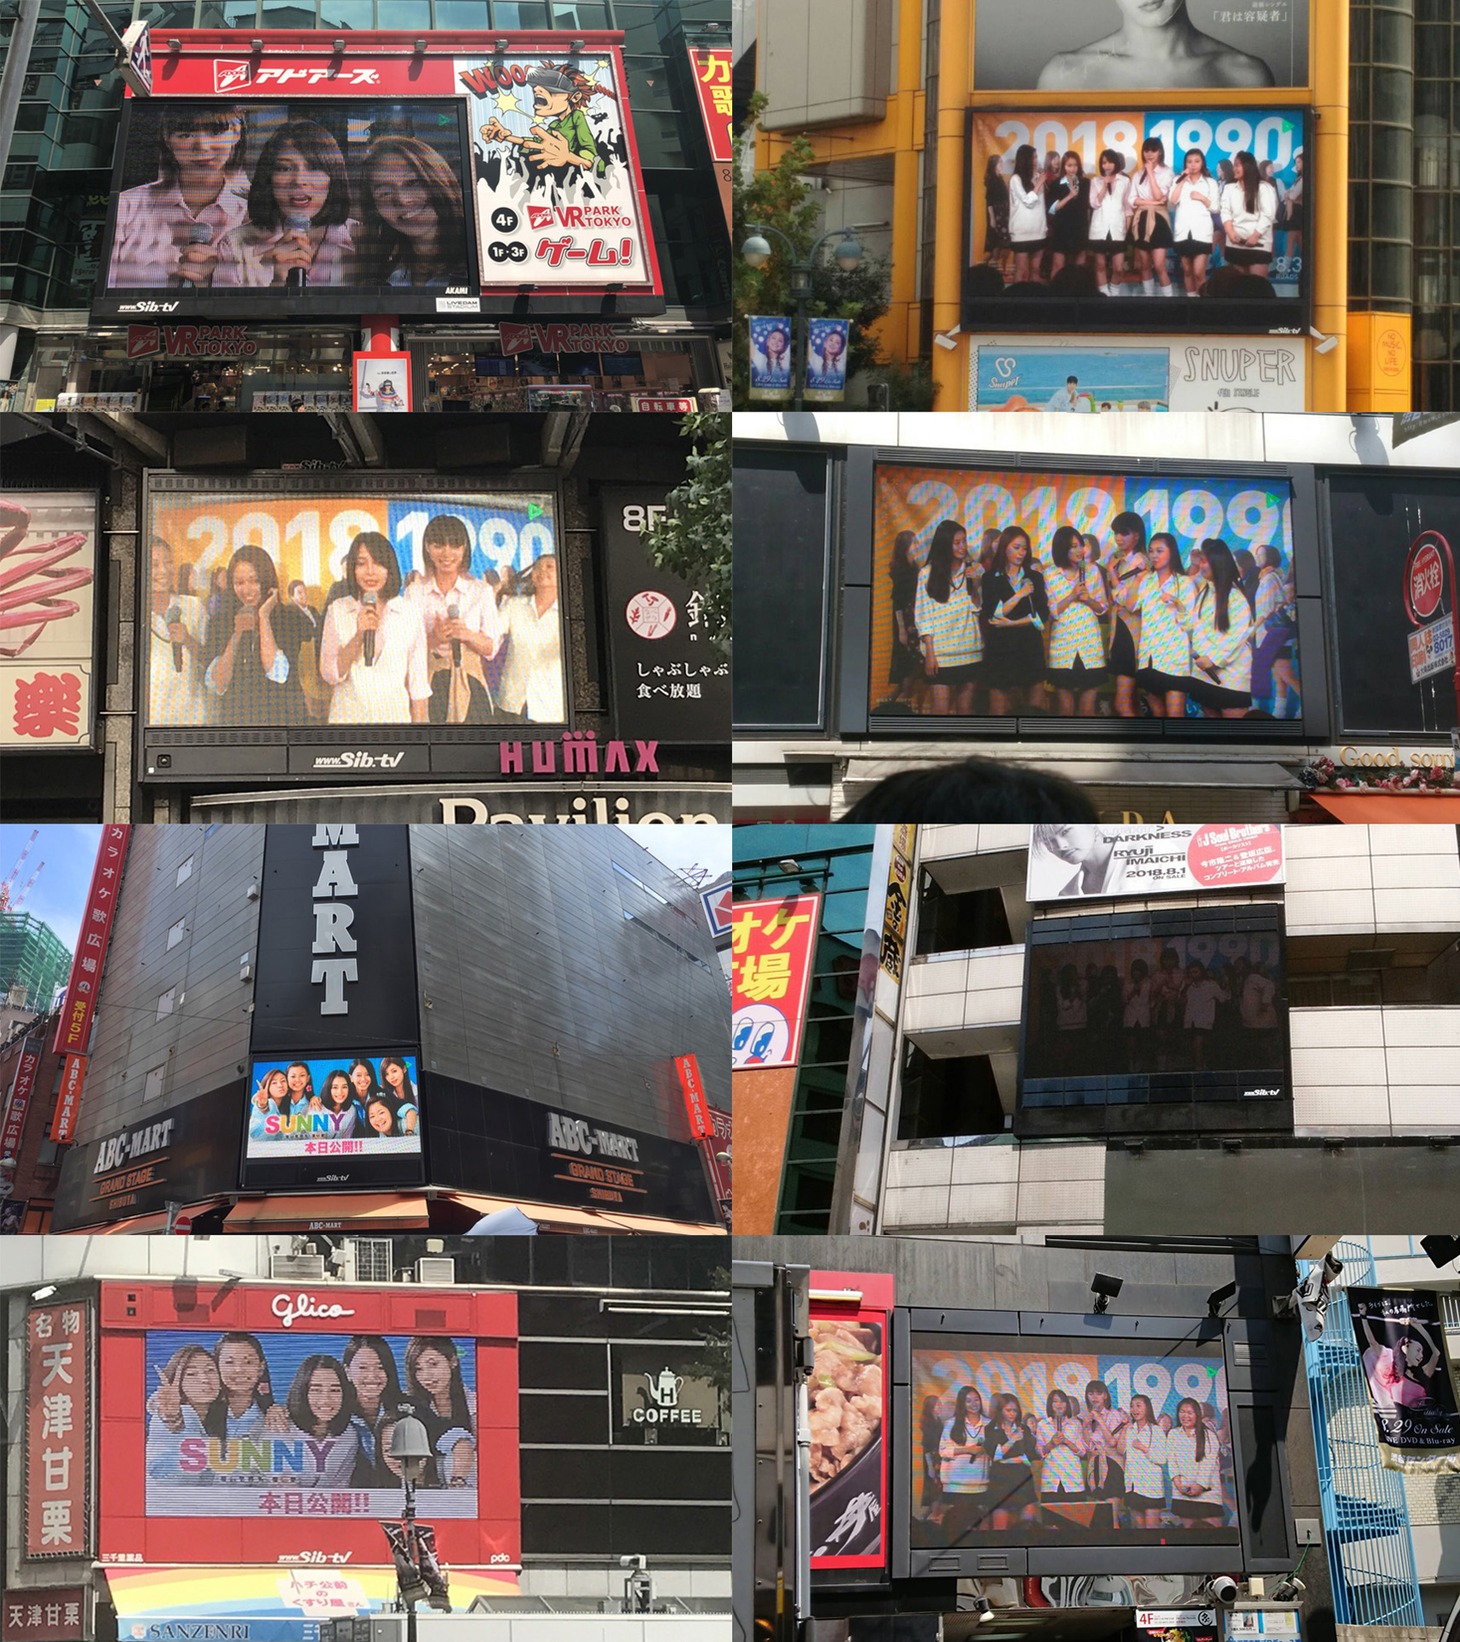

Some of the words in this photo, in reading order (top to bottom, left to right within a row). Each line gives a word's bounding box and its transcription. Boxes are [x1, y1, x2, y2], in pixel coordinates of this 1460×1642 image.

[256, 68, 380, 85] アドアーズ
[496, 214, 513, 226] 4F
[556, 207, 585, 227] VR
[585, 206, 620, 215] PARK
[585, 217, 631, 226] TOKYO
[163, 326, 199, 355] VR
[199, 325, 247, 339] PARK
[199, 340, 257, 355] TOKYO
[533, 323, 570, 352] VR
[570, 323, 615, 337] PARK
[570, 338, 629, 352] TOKYO
[1183, 346, 1297, 386] SNUPER
[1414, 561, 1440, 600] 消火栓
[1434, 635, 1453, 655] 8017
[637, 662, 729, 677] しゃぶしゃぶ
[637, 683, 702, 699] 食べ放題
[1340, 745, 1400, 767] Good
[1102, 829, 1192, 844] DARKNESS
[1209, 829, 1229, 844] Soul
[1126, 855, 1186, 866] IMAICHI
[1126, 867, 1186, 878] 2018.8.1
[82, 826, 124, 973] カラオケ歌広場
[17, 1054, 35, 1096] カラオケ
[4, 1111, 22, 1150] 歌広場
[265, 1113, 345, 1135] SUNNY
[94, 1117, 175, 1175] ABC-MART
[549, 1111, 640, 1163] ABC-MART
[569, 1162, 605, 1182] GRAND
[605, 1169, 634, 1187] STAGE
[309, 1222, 342, 1230] ABC-MART
[271, 1293, 355, 1328] Glico
[34, 1309, 80, 1338] 名物
[633, 1408, 702, 1424] COFFEE
[41, 1342, 73, 1546] 天津甘栗
[1400, 1436, 1418, 1444] DVD
[1426, 1437, 1456, 1445] Blu-ray
[180, 1437, 329, 1475] SUNNY
[490, 1553, 510, 1564] pdc
[8, 1602, 80, 1628] 天津甘栗
[1139, 1613, 1154, 1625] 4F
[149, 1622, 249, 1641] SANZENRI
